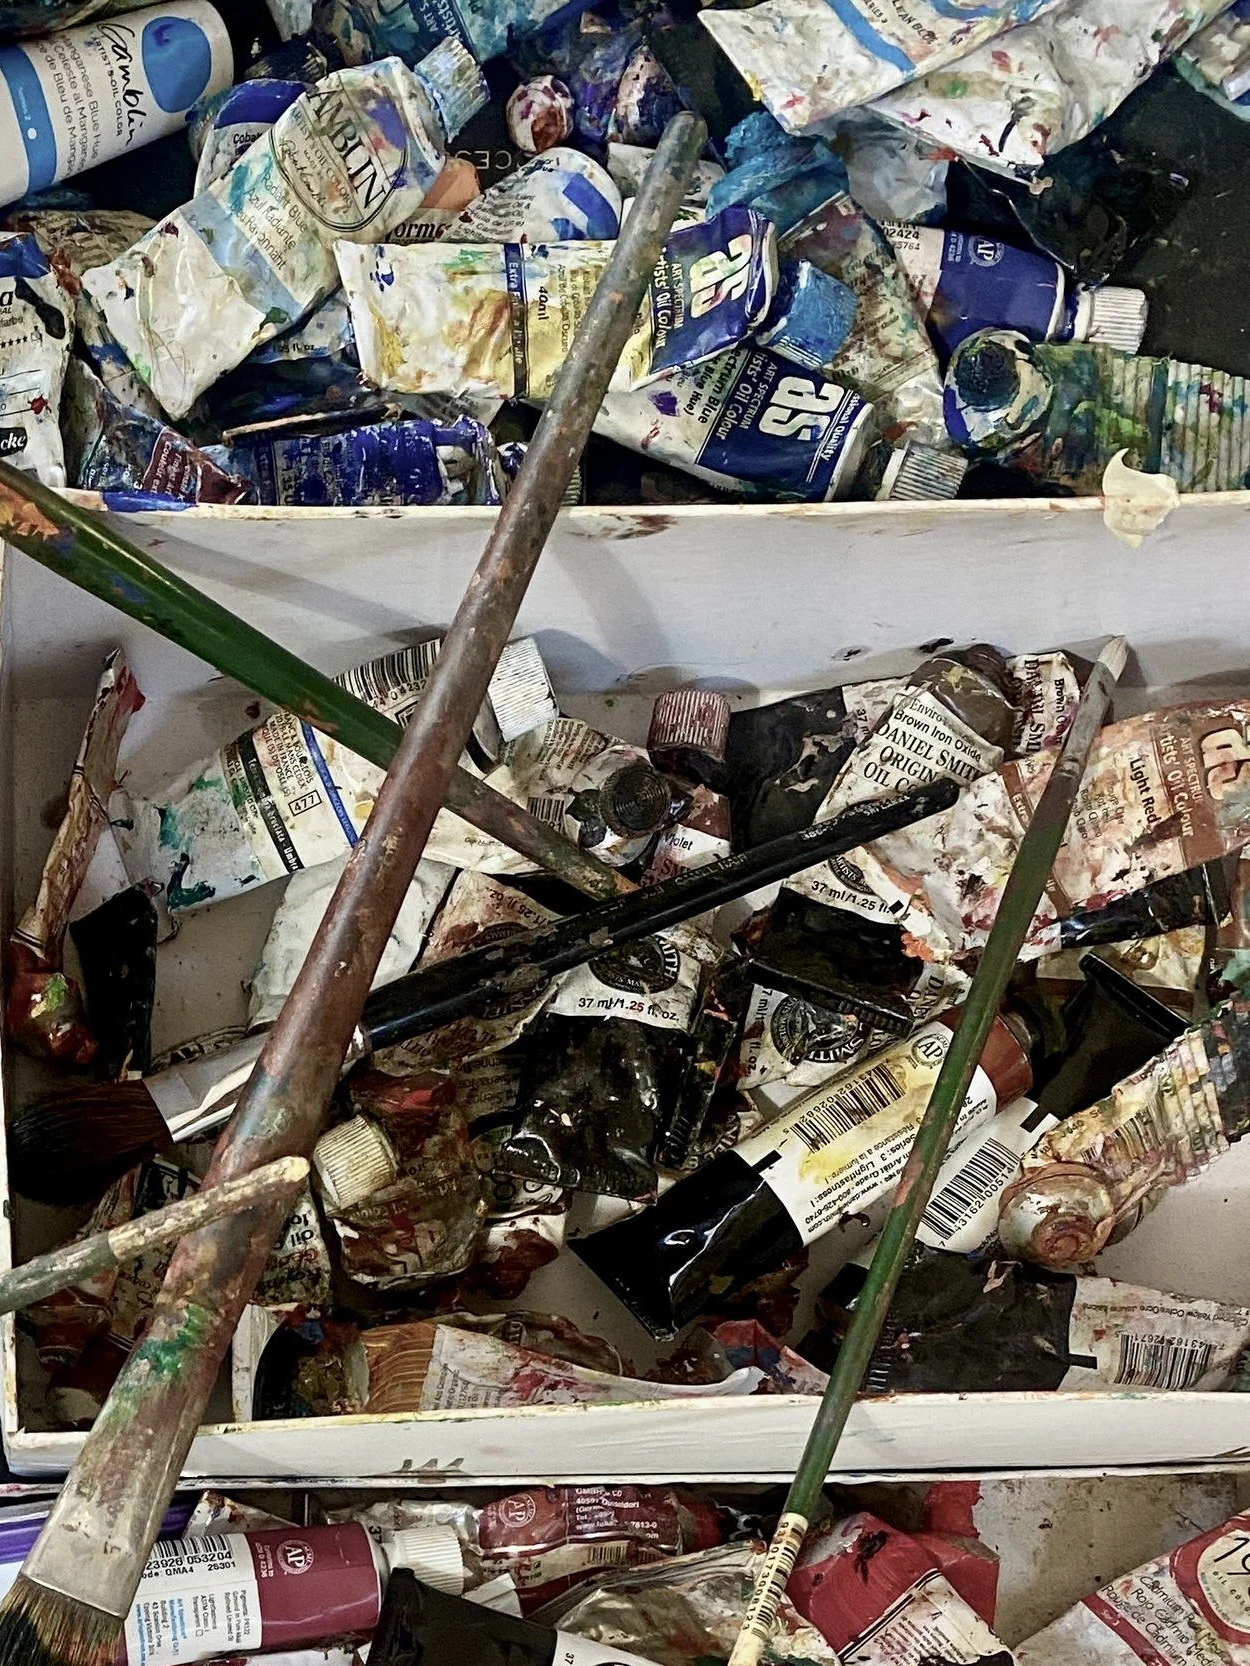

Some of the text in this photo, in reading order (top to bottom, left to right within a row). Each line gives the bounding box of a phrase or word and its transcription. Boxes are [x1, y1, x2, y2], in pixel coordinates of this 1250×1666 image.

[53, 71, 74, 124] Bleu de
[96, 20, 156, 146] Gamblin
[85, 99, 103, 130] Blue
[108, 78, 127, 135] OIL COLOR
[286, 204, 312, 232] Blue
[697, 394, 719, 425] Blue
[738, 361, 777, 429] ART SPECTRUM
[714, 382, 753, 442] Oil Colour
[876, 721, 935, 760] DANIEL
[893, 708, 984, 761] Brown Iron Oxide
[862, 761, 893, 787] OIL
[1126, 757, 1161, 823] Light Red
[811, 878, 876, 913] 37 ml/1.25
[577, 996, 594, 1009] 37
[877, 1150, 887, 1161] 3
[164, 1566, 194, 1578] QMA4
[186, 1550, 232, 1566] 053204
[1130, 1587, 1156, 1611] Rojo
[563, 1651, 575, 1665] 37
